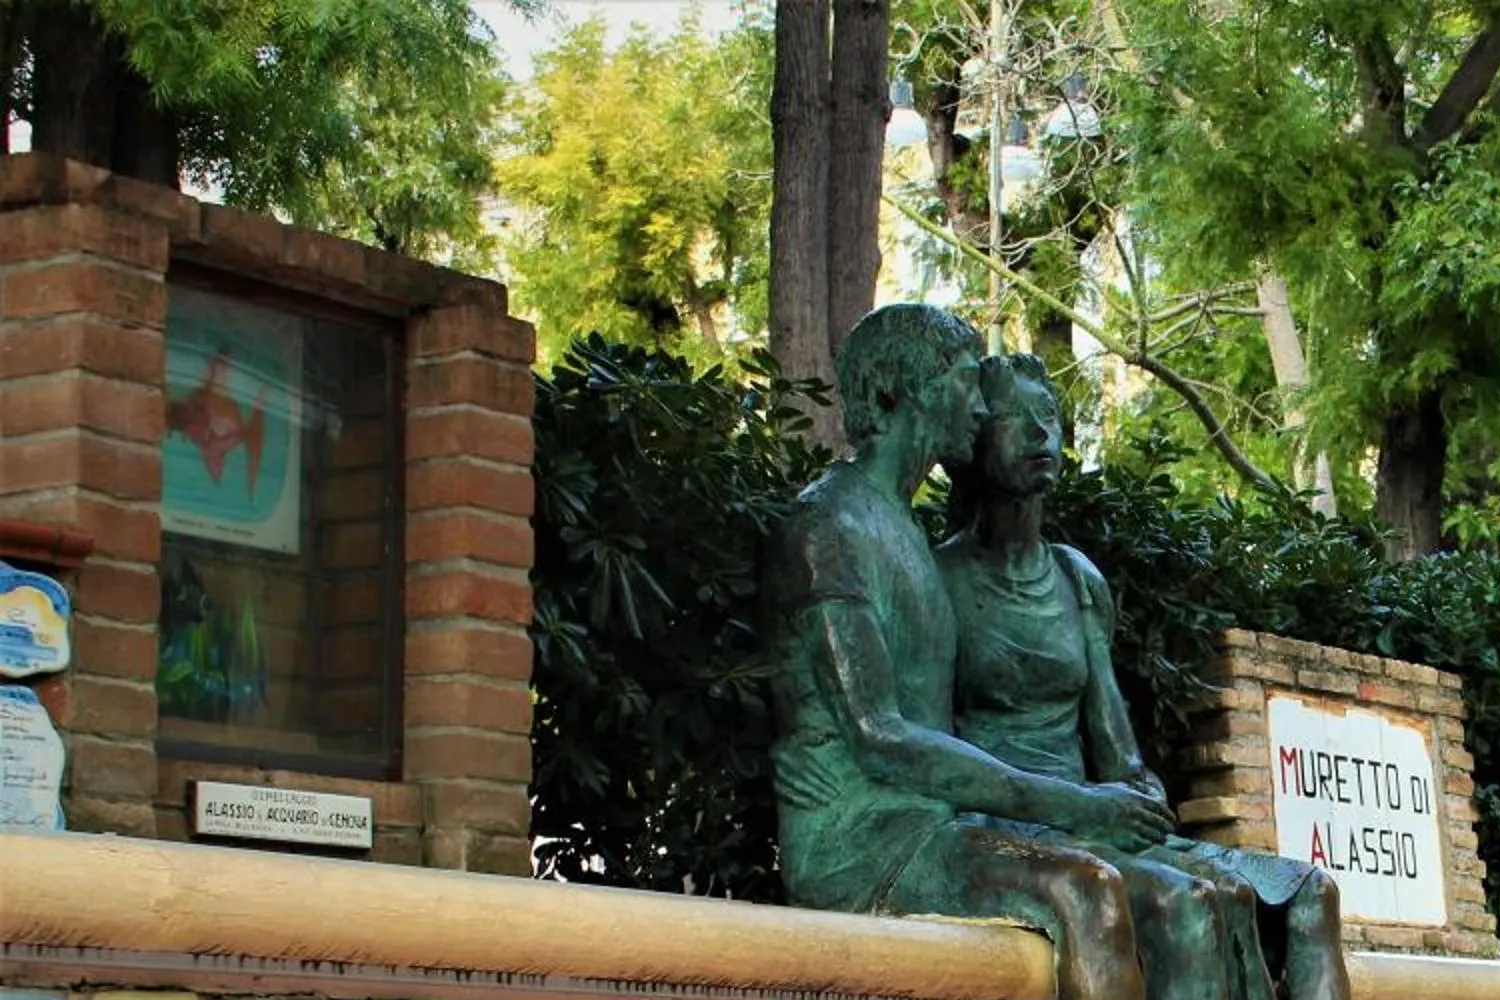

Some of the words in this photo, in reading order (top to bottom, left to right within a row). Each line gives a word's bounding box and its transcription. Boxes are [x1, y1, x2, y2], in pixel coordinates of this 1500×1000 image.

[1279, 745, 1401, 810] MURETTO
[1411, 775, 1431, 815] DI
[205, 801, 255, 820] ALASSIO
[266, 806, 319, 826] ACQUARIO
[1310, 820, 1418, 879] ALASSIO
